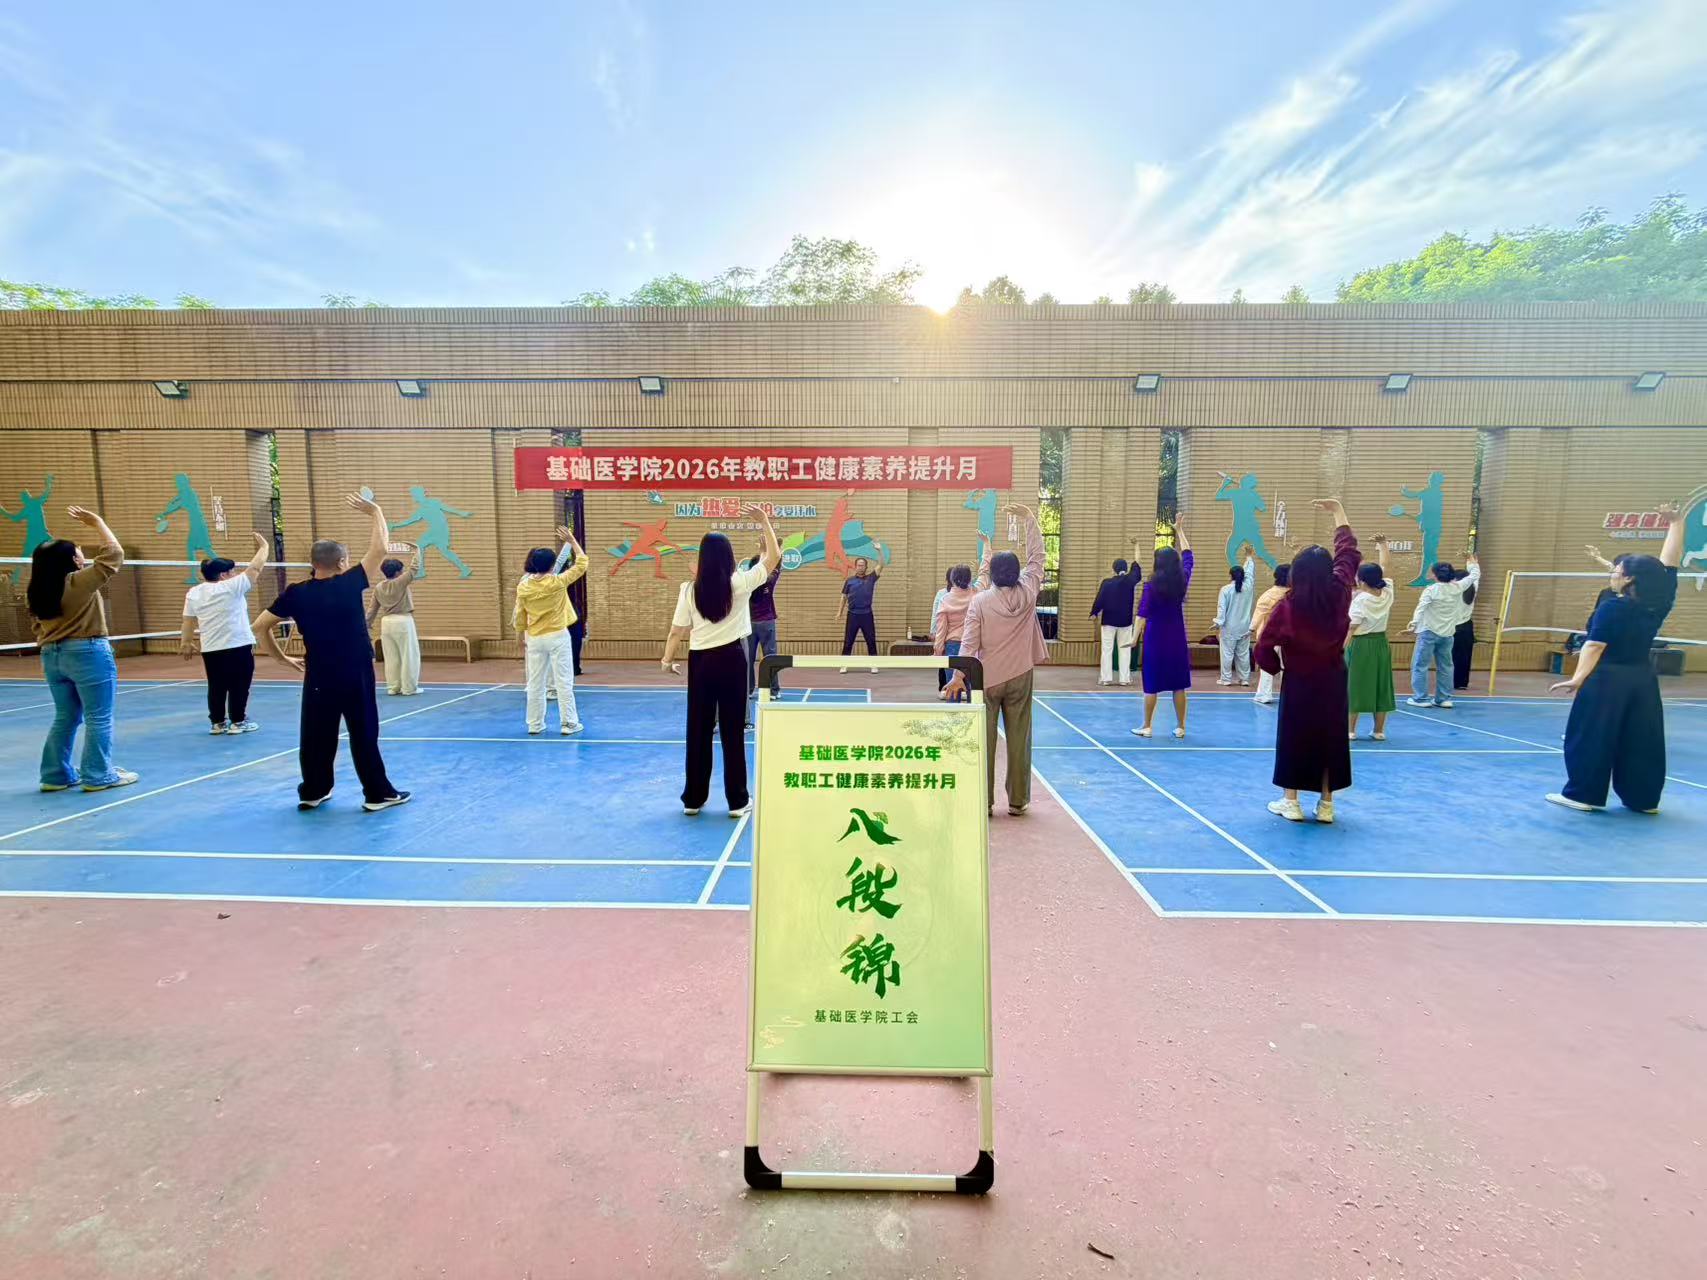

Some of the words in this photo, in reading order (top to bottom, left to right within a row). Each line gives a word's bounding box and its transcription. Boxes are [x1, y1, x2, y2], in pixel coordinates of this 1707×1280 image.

[547, 456, 976, 481] 基础医学院2026年教职工健康素养提升月
[799, 745, 942, 760] 基础医学院2026年
[784, 772, 957, 789] 教职工健康素养提升月
[836, 808, 903, 999] 八段锦
[814, 1010, 919, 1024] 基础医学院工会
